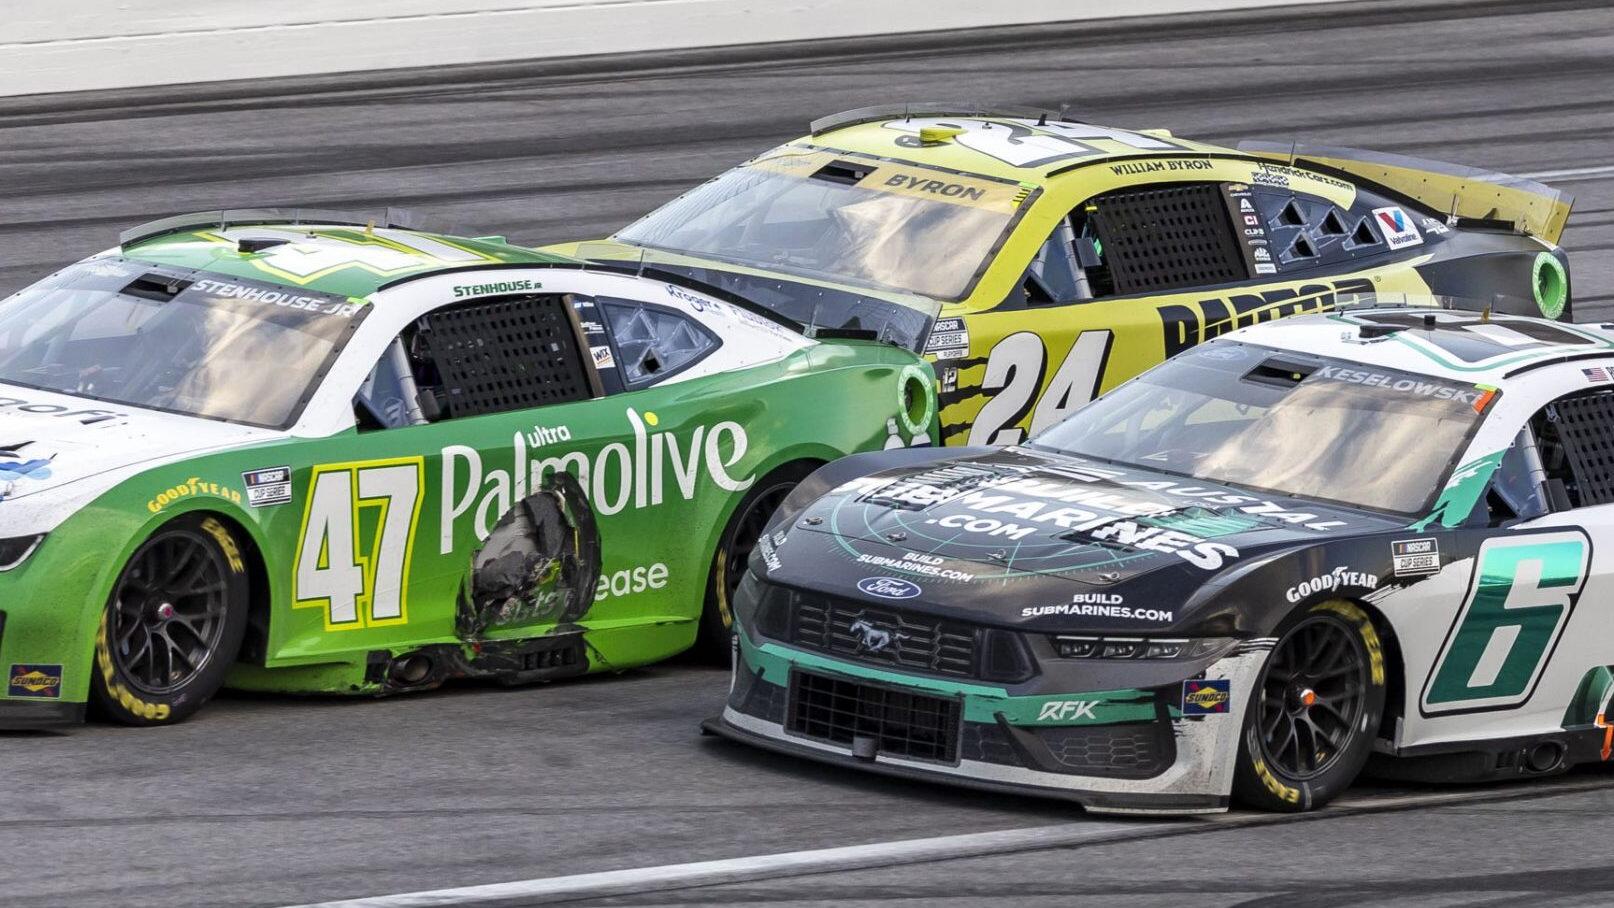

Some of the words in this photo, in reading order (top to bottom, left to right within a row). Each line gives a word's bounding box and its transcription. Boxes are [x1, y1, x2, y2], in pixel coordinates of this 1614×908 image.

[1109, 161, 1165, 176] WILLIAM
[1167, 159, 1213, 171] BYRON
[884, 174, 988, 201] BYRON
[191, 279, 326, 311] STENHOUSE
[453, 280, 532, 297] STENHOUSE
[941, 334, 962, 345] SERIES
[968, 329, 1114, 446] 24
[528, 424, 571, 449] ultra
[440, 408, 756, 555] Palmolive
[1121, 481, 1348, 531] AUSTAL
[925, 514, 1039, 541] .COM
[294, 461, 422, 628] 47
[1406, 541, 1431, 553] NASCAR
[856, 554, 974, 582] SUBMARINES.COM
[902, 552, 944, 565] BUILD
[1400, 557, 1412, 568] CUP
[1412, 556, 1433, 567] SERIES
[594, 562, 669, 601] ease
[866, 578, 913, 597] Ford
[1286, 566, 1378, 603] GOODYEAR
[1073, 593, 1123, 605] BUILD
[1021, 606, 1173, 622] SUBMARINES.COM
[1427, 540, 1583, 704] 6
[1037, 700, 1100, 721] RFK
[1186, 692, 1228, 704] SUNOCO
